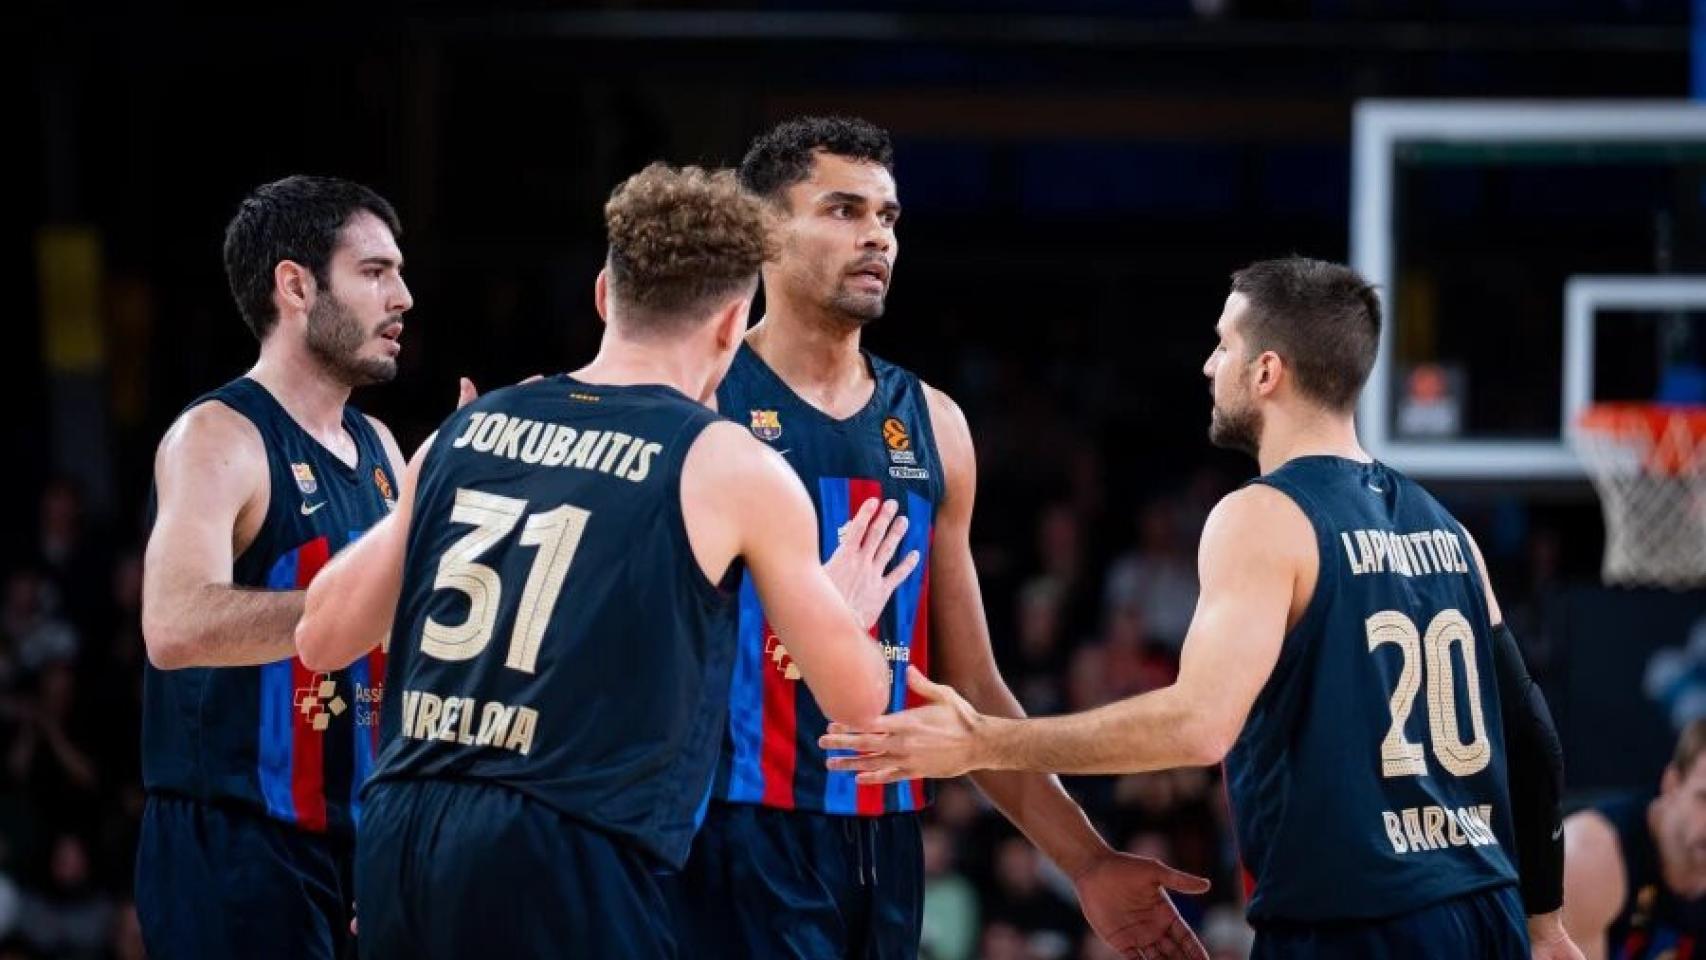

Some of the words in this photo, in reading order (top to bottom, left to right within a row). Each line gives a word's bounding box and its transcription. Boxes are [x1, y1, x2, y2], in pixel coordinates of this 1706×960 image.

[453, 411, 663, 482] JOKUBAITIS
[420, 487, 592, 674] 31
[1365, 608, 1491, 777] 20
